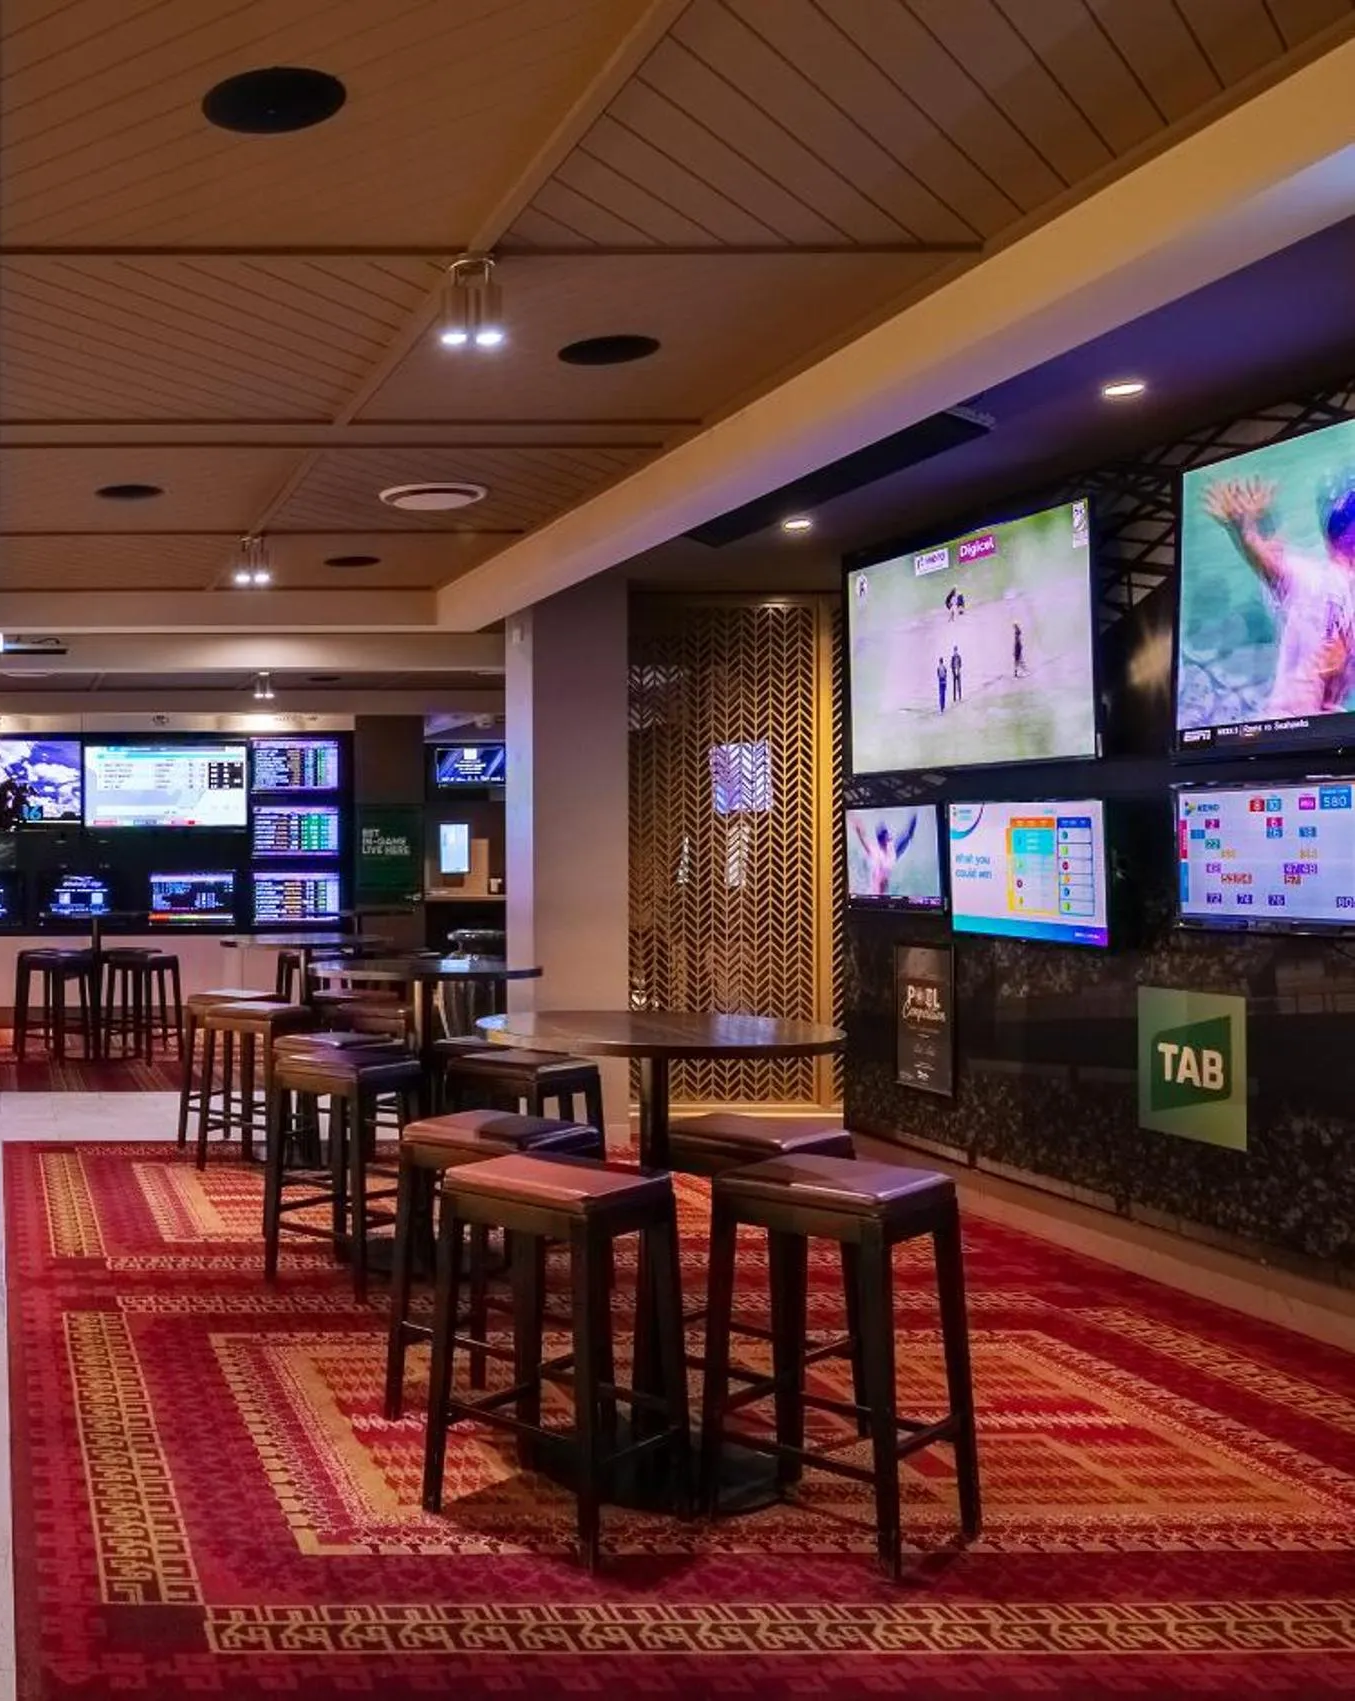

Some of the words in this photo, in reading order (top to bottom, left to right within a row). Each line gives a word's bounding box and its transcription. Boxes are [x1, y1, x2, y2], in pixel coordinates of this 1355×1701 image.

[960, 536, 995, 557] Digicel
[1183, 729, 1212, 742] ESPN
[1197, 803, 1220, 813] KENO
[1323, 795, 1348, 808] 580
[1157, 1042, 1224, 1090] TAB
